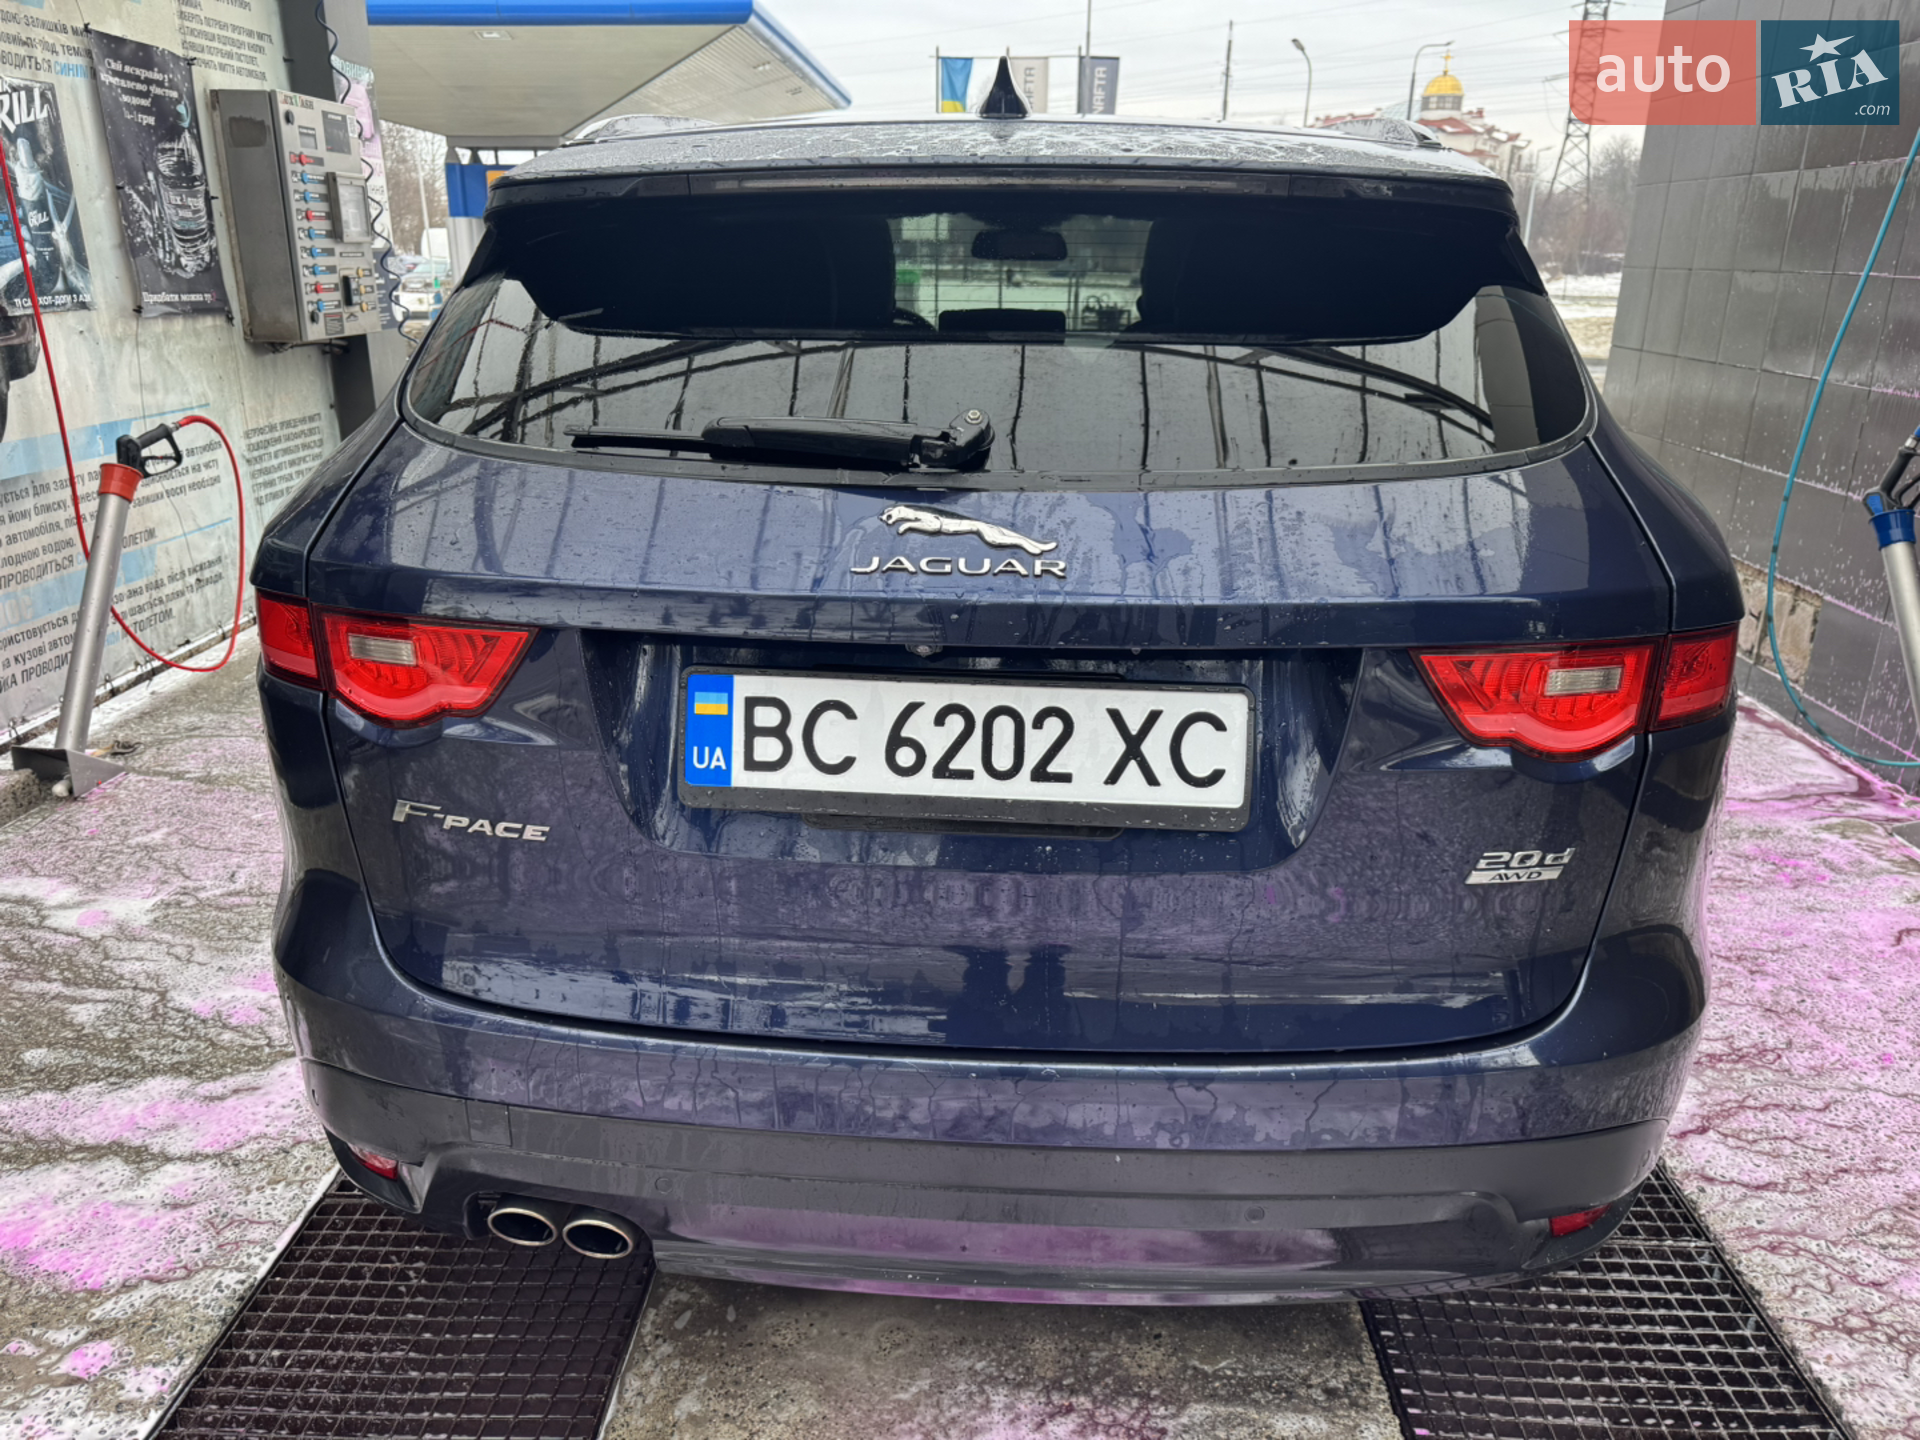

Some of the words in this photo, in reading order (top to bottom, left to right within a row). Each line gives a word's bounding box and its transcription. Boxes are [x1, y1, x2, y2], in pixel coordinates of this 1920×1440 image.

[1092, 66, 1107, 115] NAFTA
[32, 483, 52, 499] для
[8, 509, 32, 527] йому
[33, 498, 70, 517] блиску.
[42, 537, 77, 556] водою.
[121, 527, 158, 549] ОЛЕТОМ.
[850, 556, 1067, 579] JAGUAR
[13, 641, 48, 666] кузові
[742, 696, 858, 776] BC
[884, 701, 1076, 784] 6202
[1103, 707, 1229, 789] XC
[692, 745, 727, 770] UA
[391, 799, 551, 842] F-PACE
[1475, 847, 1576, 869] 20d
[1489, 871, 1543, 882] AWD
